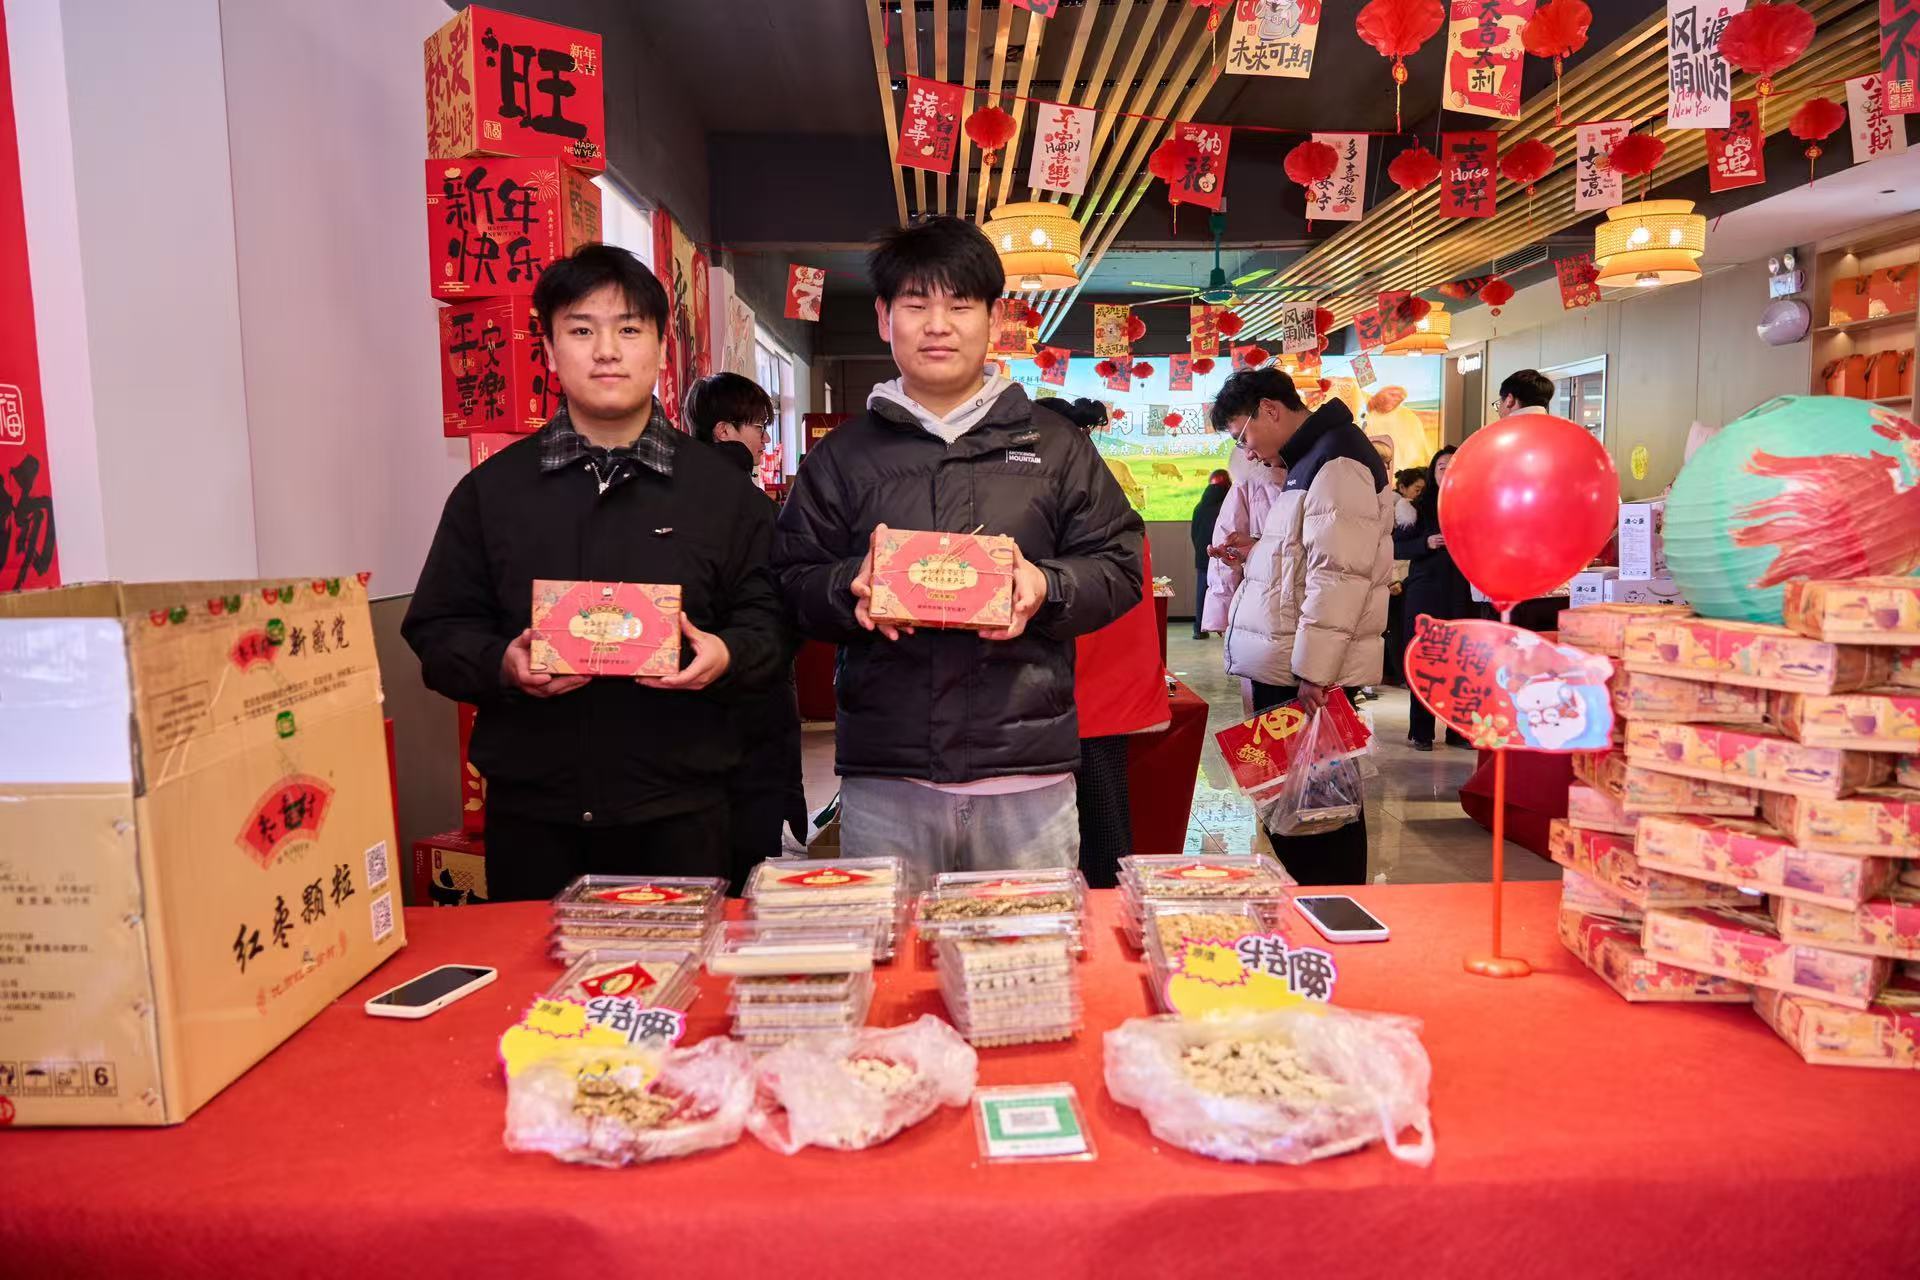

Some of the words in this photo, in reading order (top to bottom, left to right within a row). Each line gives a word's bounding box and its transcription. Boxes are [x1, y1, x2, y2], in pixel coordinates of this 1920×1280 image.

[569, 42, 597, 61] 新年
[1229, 36, 1312, 72] 未來可期
[570, 60, 597, 77] 大吉
[1670, 51, 1728, 101] 雨顺
[498, 43, 588, 139] 旺
[1672, 103, 1692, 118] New
[563, 145, 581, 156] NEW
[581, 147, 602, 159] YEAR
[574, 140, 601, 152] HAPPY
[1045, 140, 1081, 154] Happy
[1449, 167, 1490, 183] Horse
[443, 166, 541, 234] 新年
[448, 229, 544, 284] 快乐
[450, 312, 507, 374] 平安
[455, 370, 507, 421] 喜樂
[1008, 455, 1042, 464] MOUNTAIN
[232, 862, 356, 975] 红枣颗粒
[94, 1066, 109, 1087] 6
